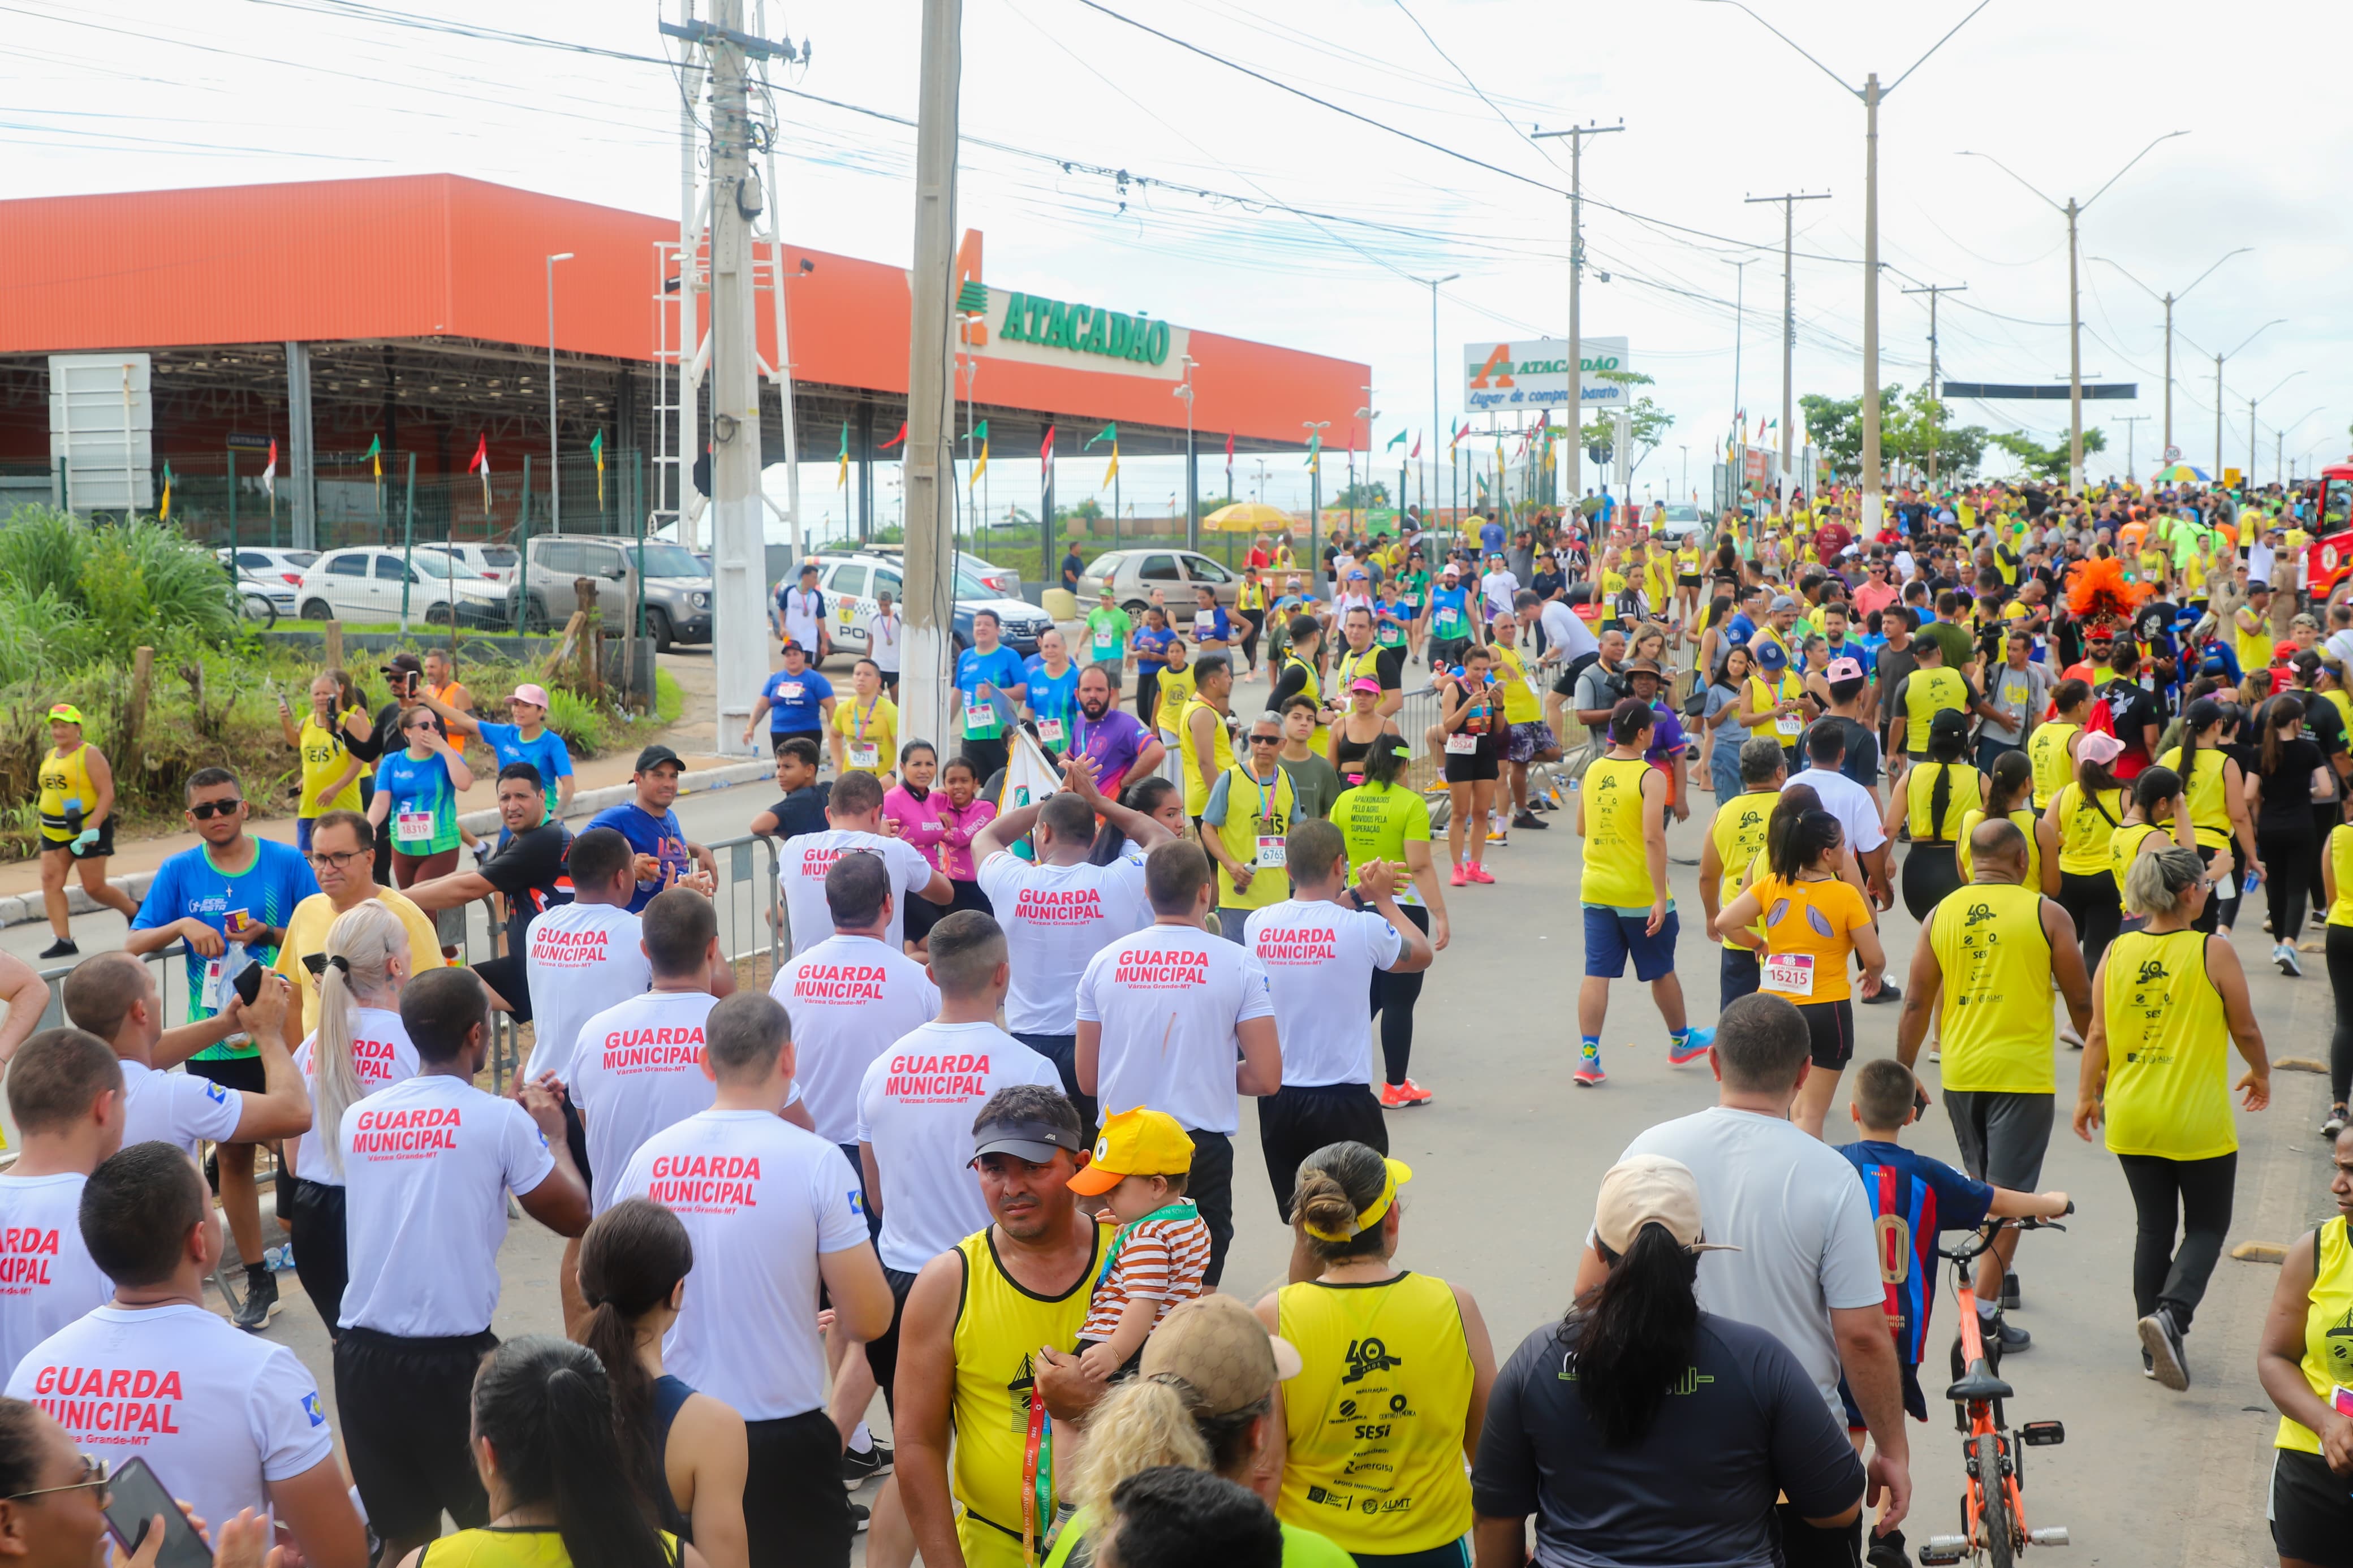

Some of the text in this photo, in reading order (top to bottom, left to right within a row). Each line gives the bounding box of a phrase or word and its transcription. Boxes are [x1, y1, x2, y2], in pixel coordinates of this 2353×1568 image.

[999, 291, 1170, 366] ATACADÃO
[1516, 355, 1619, 374] ATACDÃO
[1470, 391, 1505, 409] Lugar
[1510, 388, 1524, 403] de
[1581, 386, 1619, 400] barato
[1354, 795, 1390, 804] APAIXONADOS
[962, 814, 989, 837] BRFOX
[1351, 815, 1373, 823] MOVIDOS
[402, 824, 428, 835] 18319
[1263, 849, 1284, 860] 6765
[1019, 888, 1101, 905] GUARDA
[1015, 904, 1104, 920] MUNICIPAL
[536, 926, 609, 947] GUARDA
[1259, 927, 1337, 943] GUARDA
[531, 943, 607, 961] MUNICIPAL
[1118, 949, 1209, 967] GUARDA
[1256, 944, 1336, 960] MUNICIPAL
[798, 964, 887, 982] GUARDA
[1114, 966, 1207, 985] MUNICIPAL
[1770, 969, 1808, 985] 15215
[794, 981, 884, 1000] MUNICIPAL
[604, 1026, 705, 1049] GUARDA
[603, 1046, 700, 1070] MUNICIPAL
[890, 1054, 990, 1074] GUARDA
[616, 1067, 643, 1075] Várzea
[885, 1075, 986, 1096] MUNICIPAL
[357, 1108, 462, 1131] GUARDA
[353, 1129, 457, 1154] MUNICIPAL
[395, 1151, 437, 1160] Grande-MT
[652, 1155, 761, 1180] GUARDA
[649, 1180, 757, 1207] MUNICIPAL
[694, 1205, 738, 1216] Grande-MT
[1345, 1337, 1386, 1367] 40
[35, 1366, 183, 1401] GUARDA
[85, 1434, 150, 1446] Grande-MT
[1354, 1462, 1393, 1472] energisa
[1024, 1487, 1030, 1495] 40
[1382, 1497, 1411, 1509] ALMT
